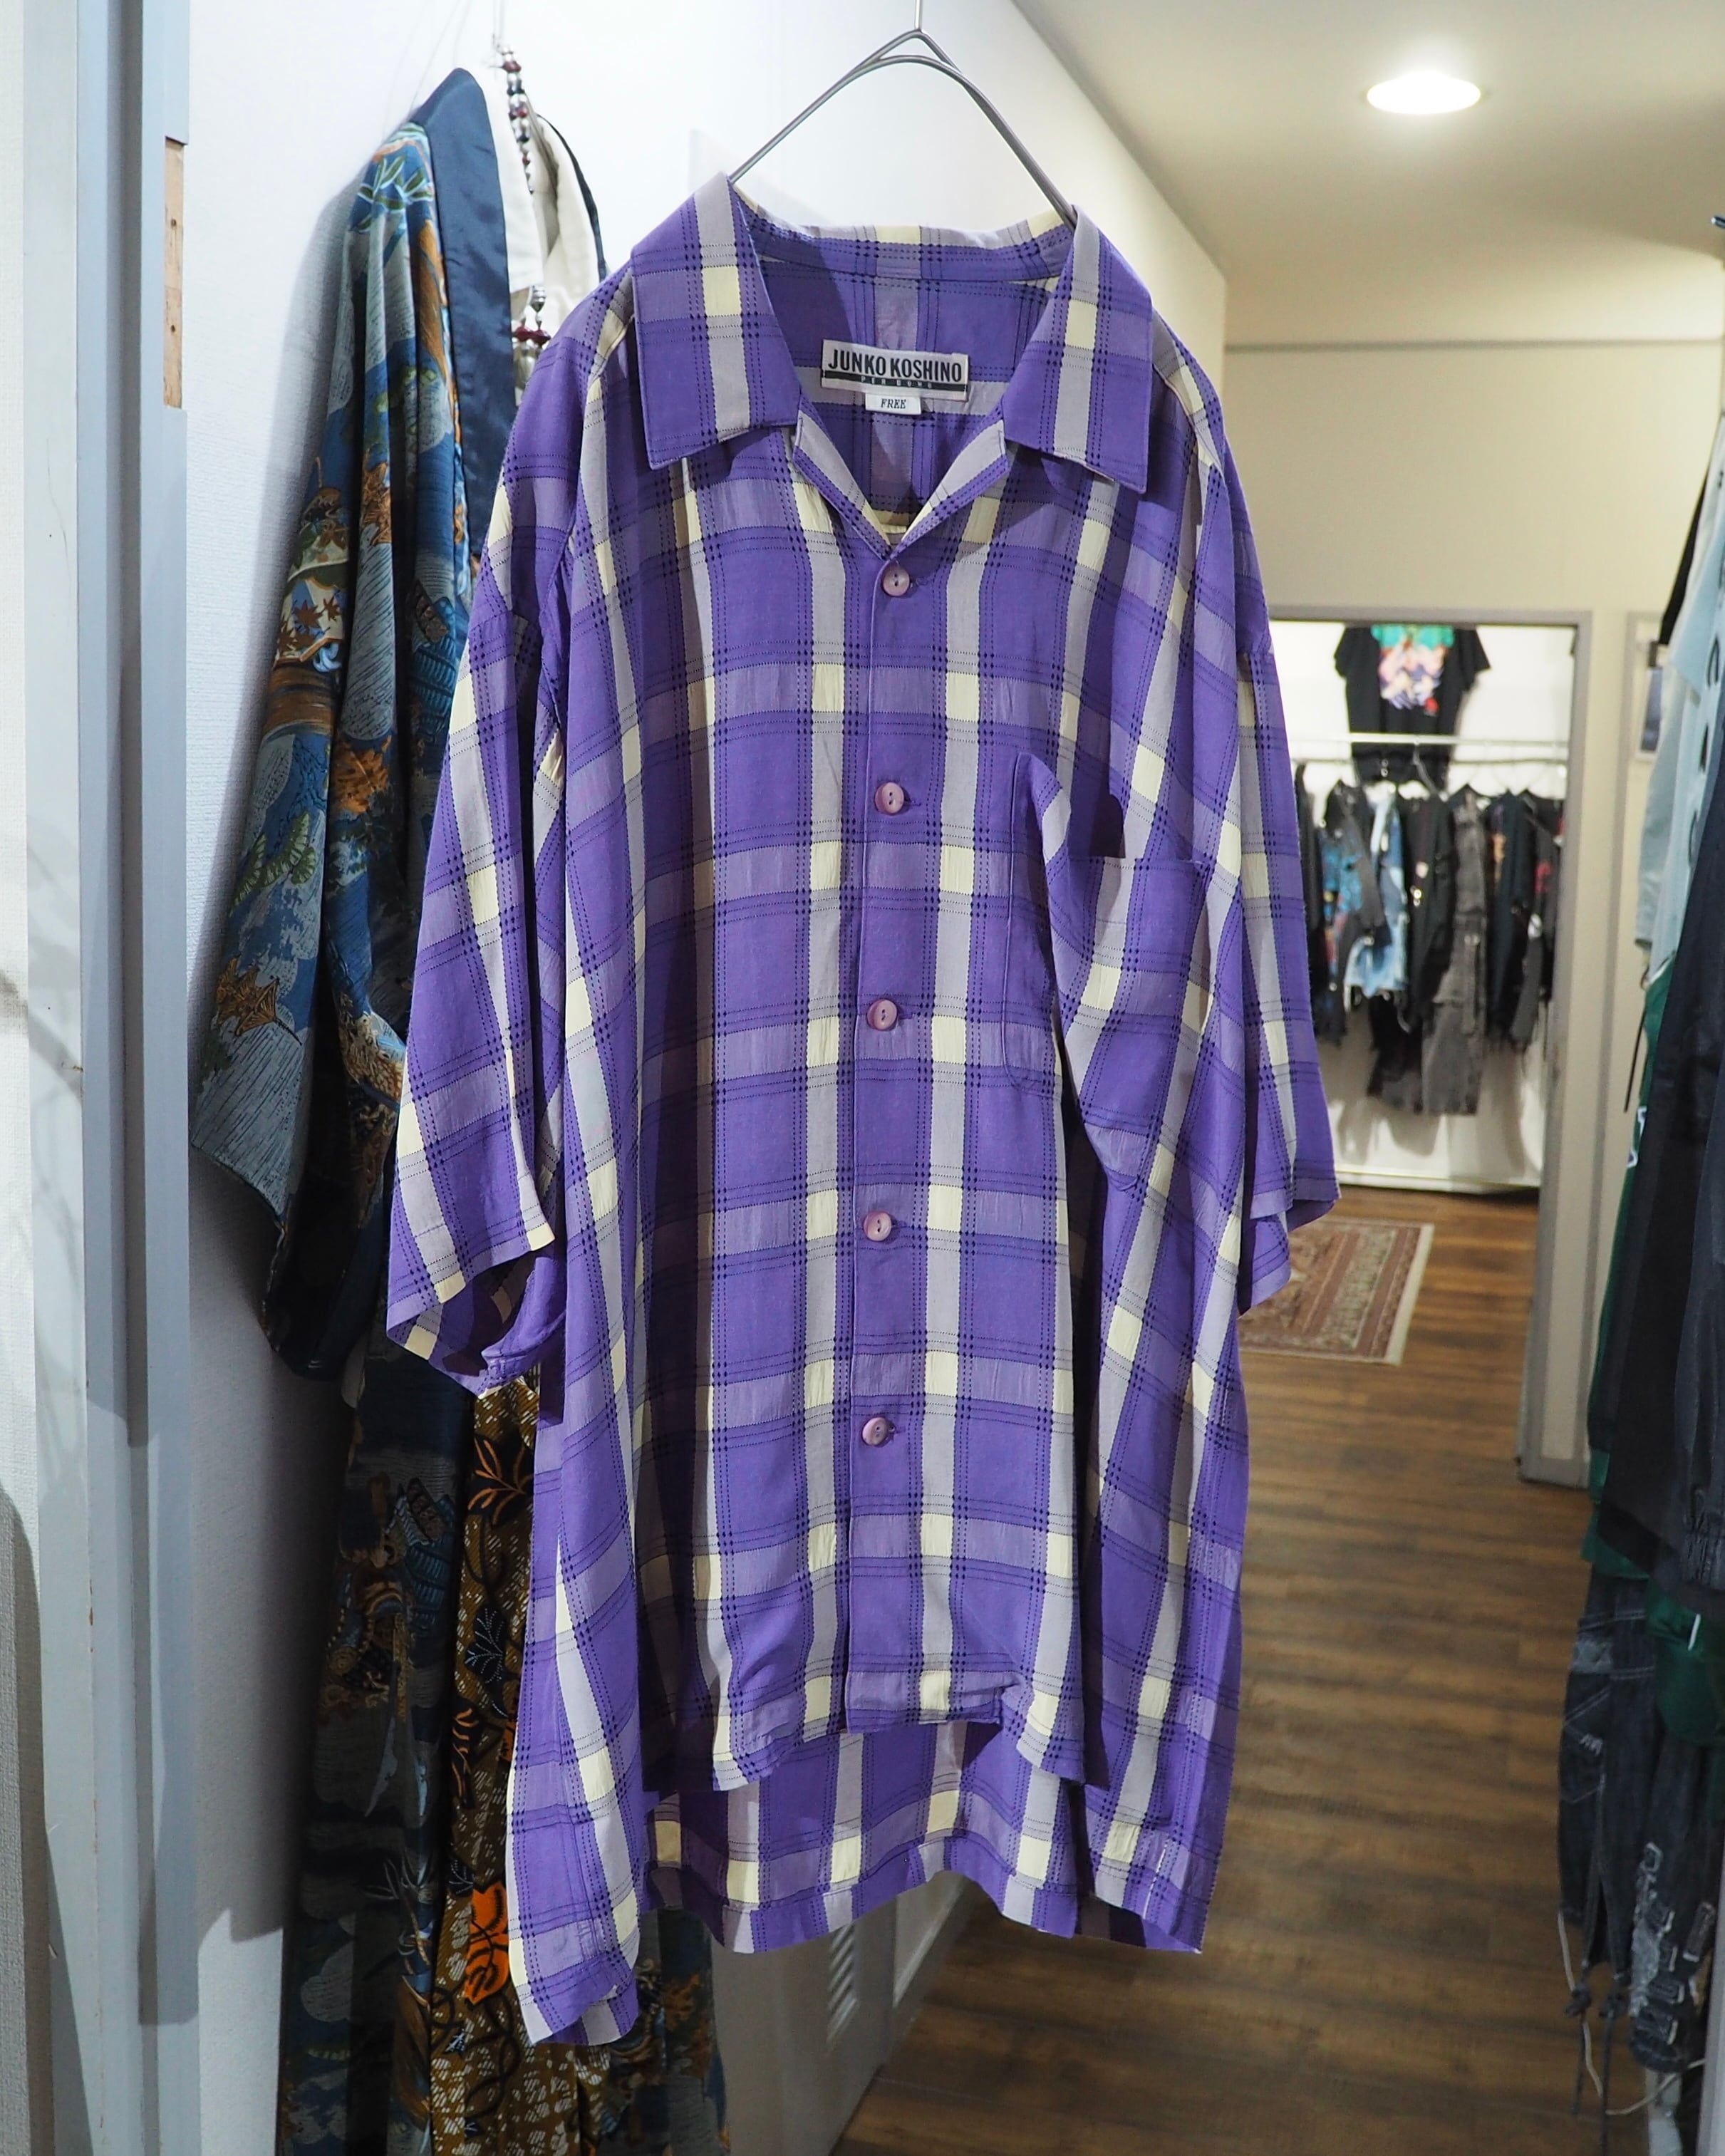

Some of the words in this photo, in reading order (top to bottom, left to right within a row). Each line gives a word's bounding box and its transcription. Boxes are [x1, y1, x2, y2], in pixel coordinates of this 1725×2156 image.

[828, 349, 886, 376] JUNKO
[891, 358, 962, 382] KOSHINO
[861, 375, 886, 385] PER
[881, 398, 906, 409] FREE
